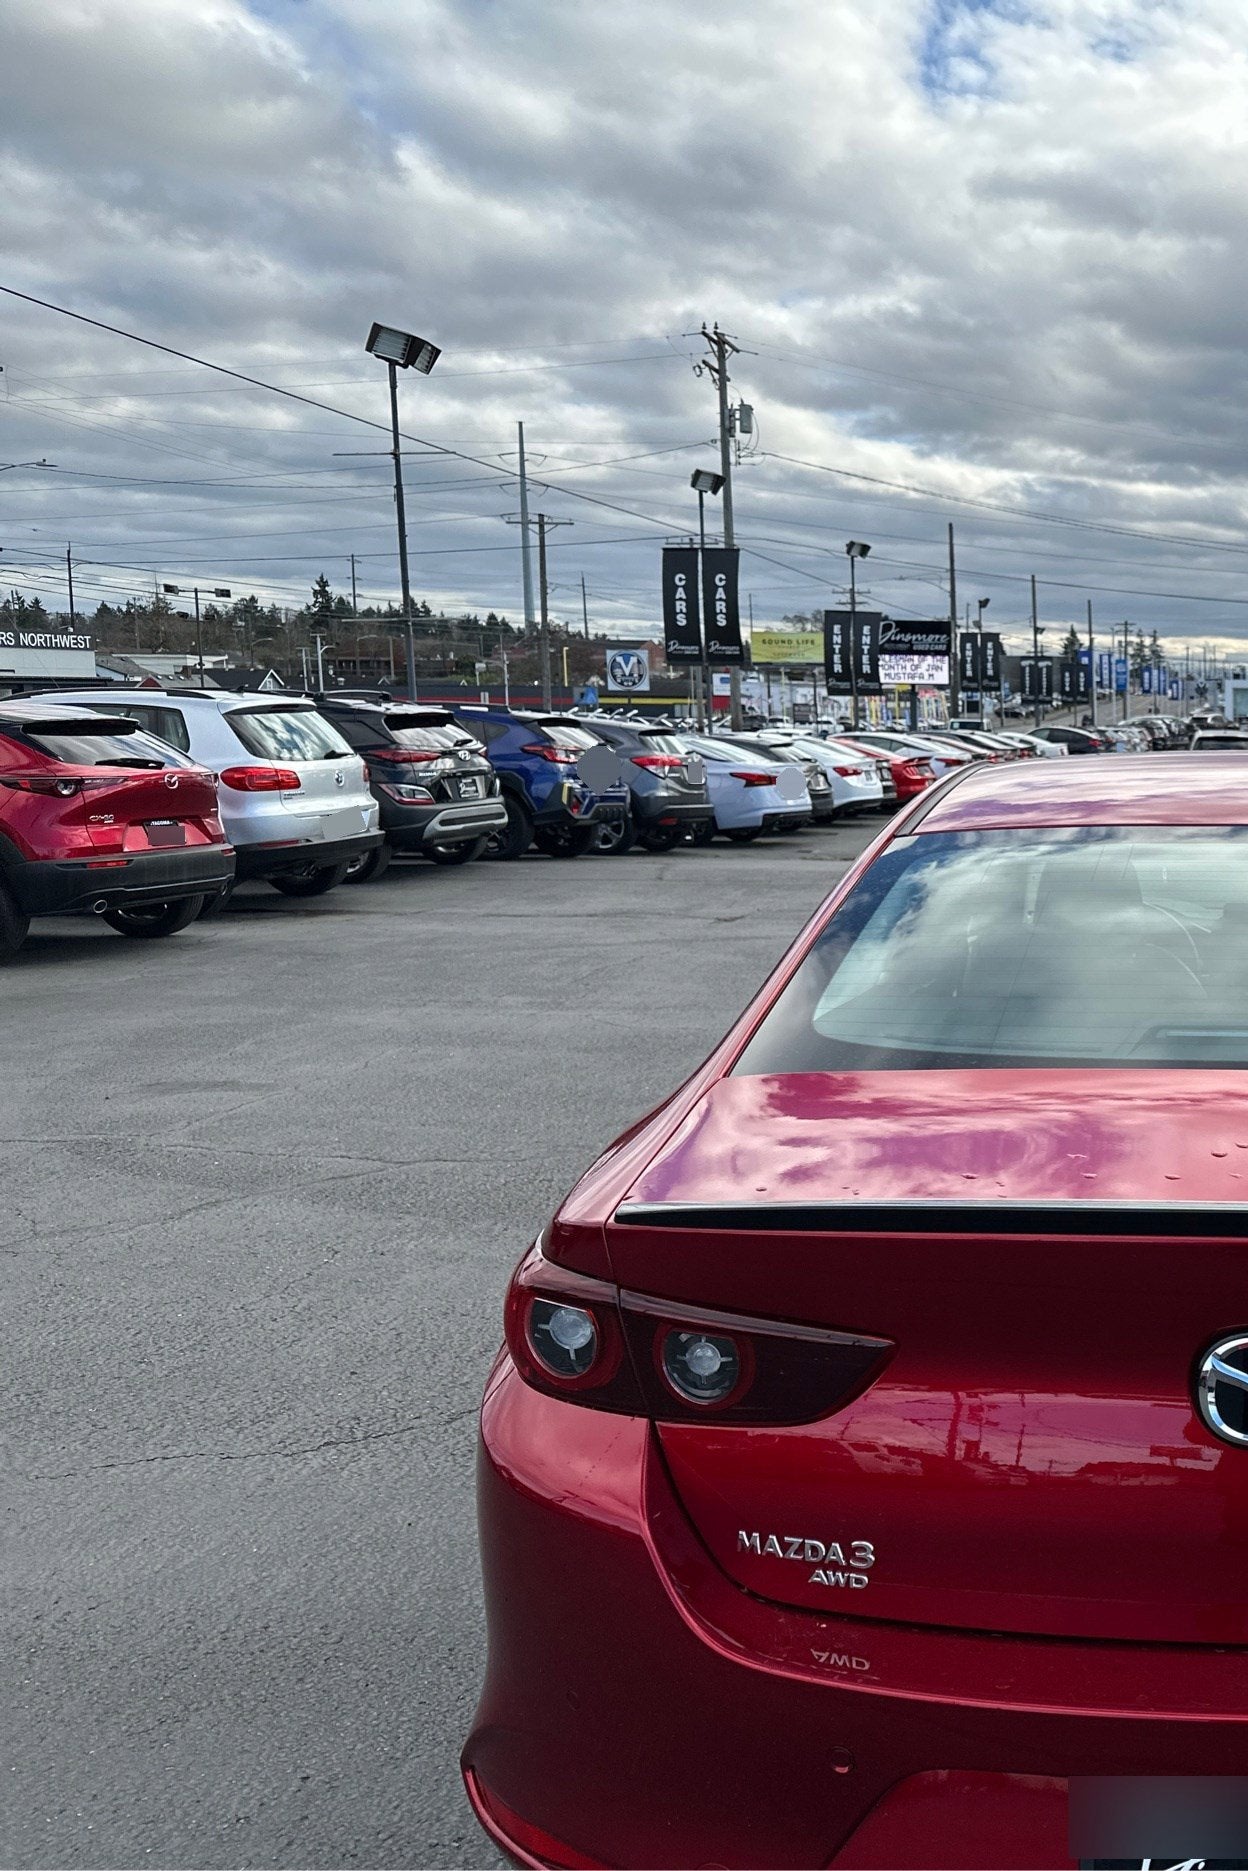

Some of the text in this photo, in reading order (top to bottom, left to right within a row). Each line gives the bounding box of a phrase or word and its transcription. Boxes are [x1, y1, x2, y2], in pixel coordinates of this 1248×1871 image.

[675, 573, 687, 627] CARS
[715, 573, 727, 627] CARS
[19, 633, 91, 648] NORTHWEST
[833, 624, 842, 674] ENTER
[862, 625, 871, 674] ENTER
[878, 621, 950, 645] Dinsmore
[926, 664, 943, 672] JAN
[808, 1569, 868, 1589] AWD
